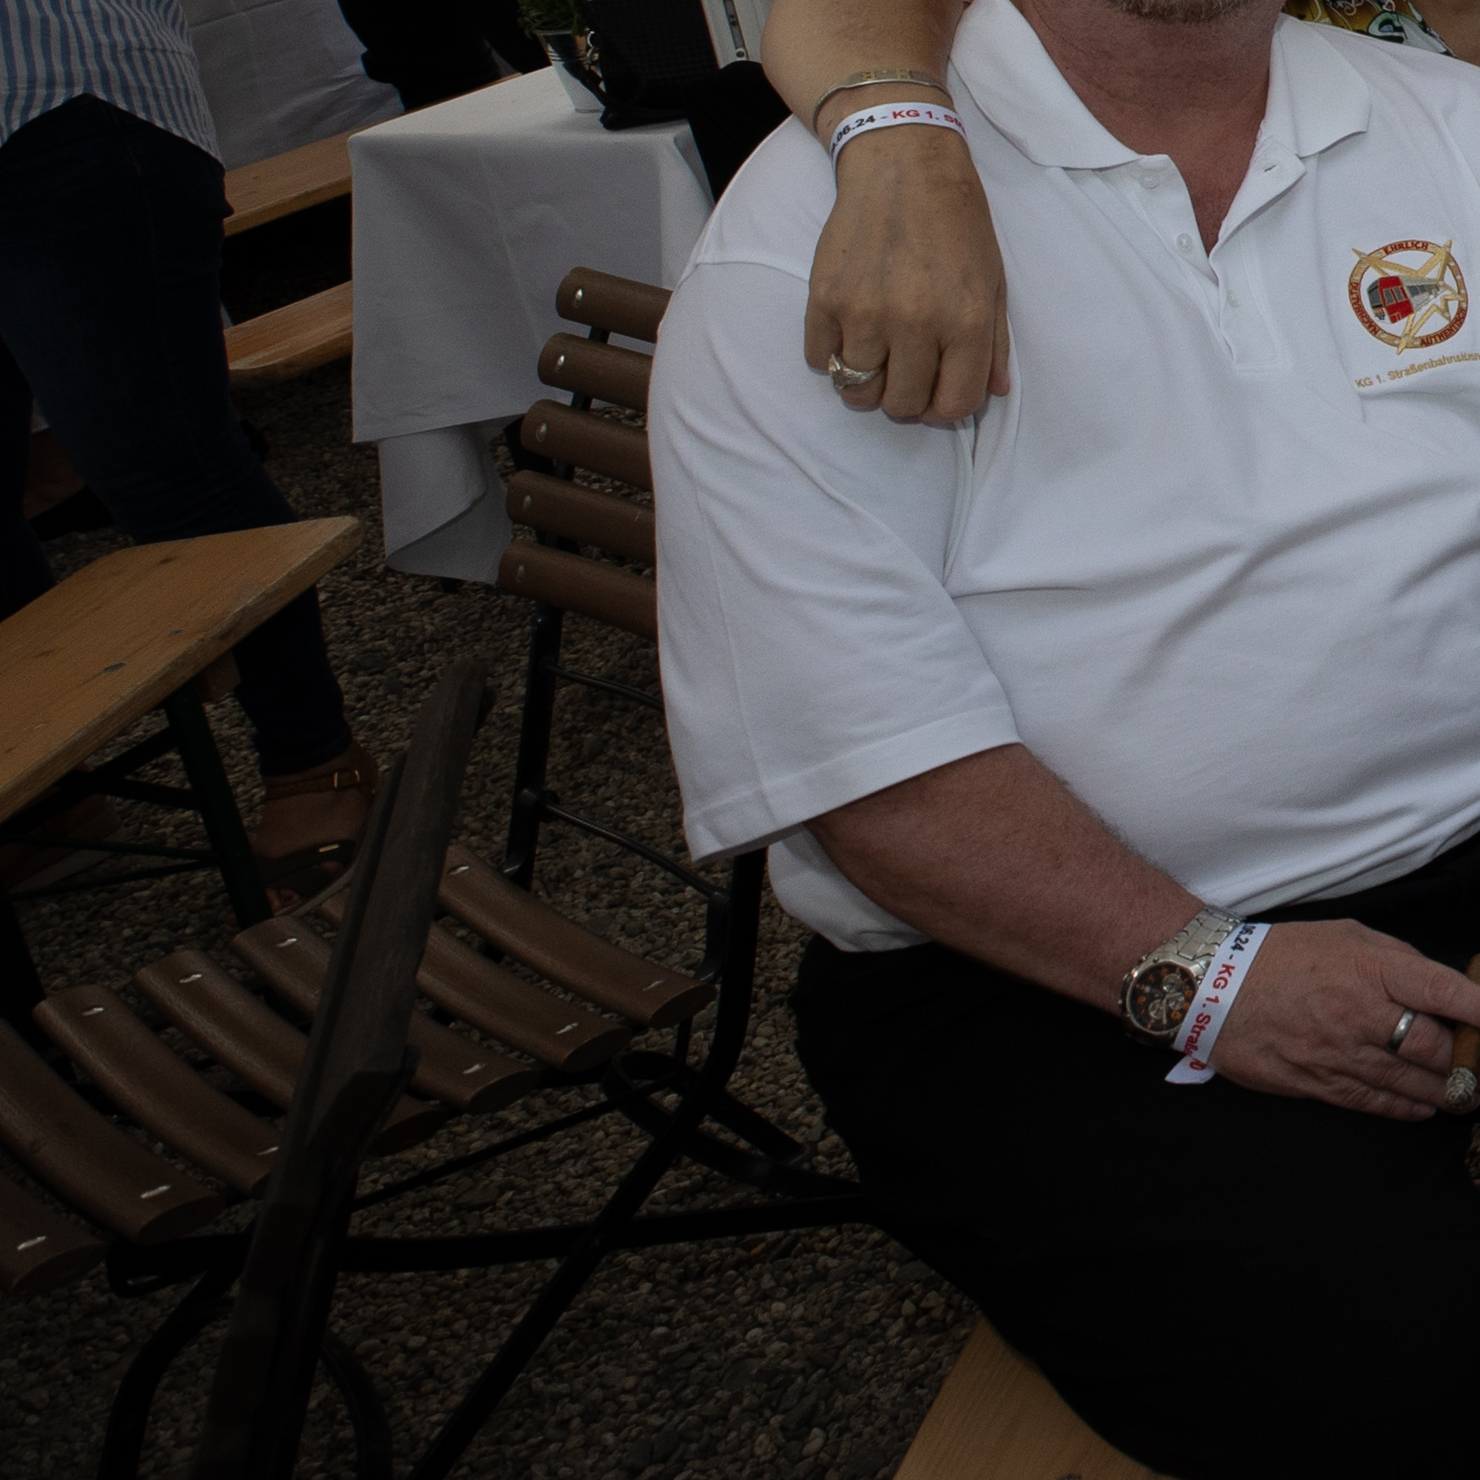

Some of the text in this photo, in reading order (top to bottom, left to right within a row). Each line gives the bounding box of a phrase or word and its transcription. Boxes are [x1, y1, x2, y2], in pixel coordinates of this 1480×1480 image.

[892, 109, 921, 120] KG
[1382, 240, 1430, 255] EHRLICH
[1354, 377, 1374, 389] KG
[1212, 962, 1236, 990] KG
